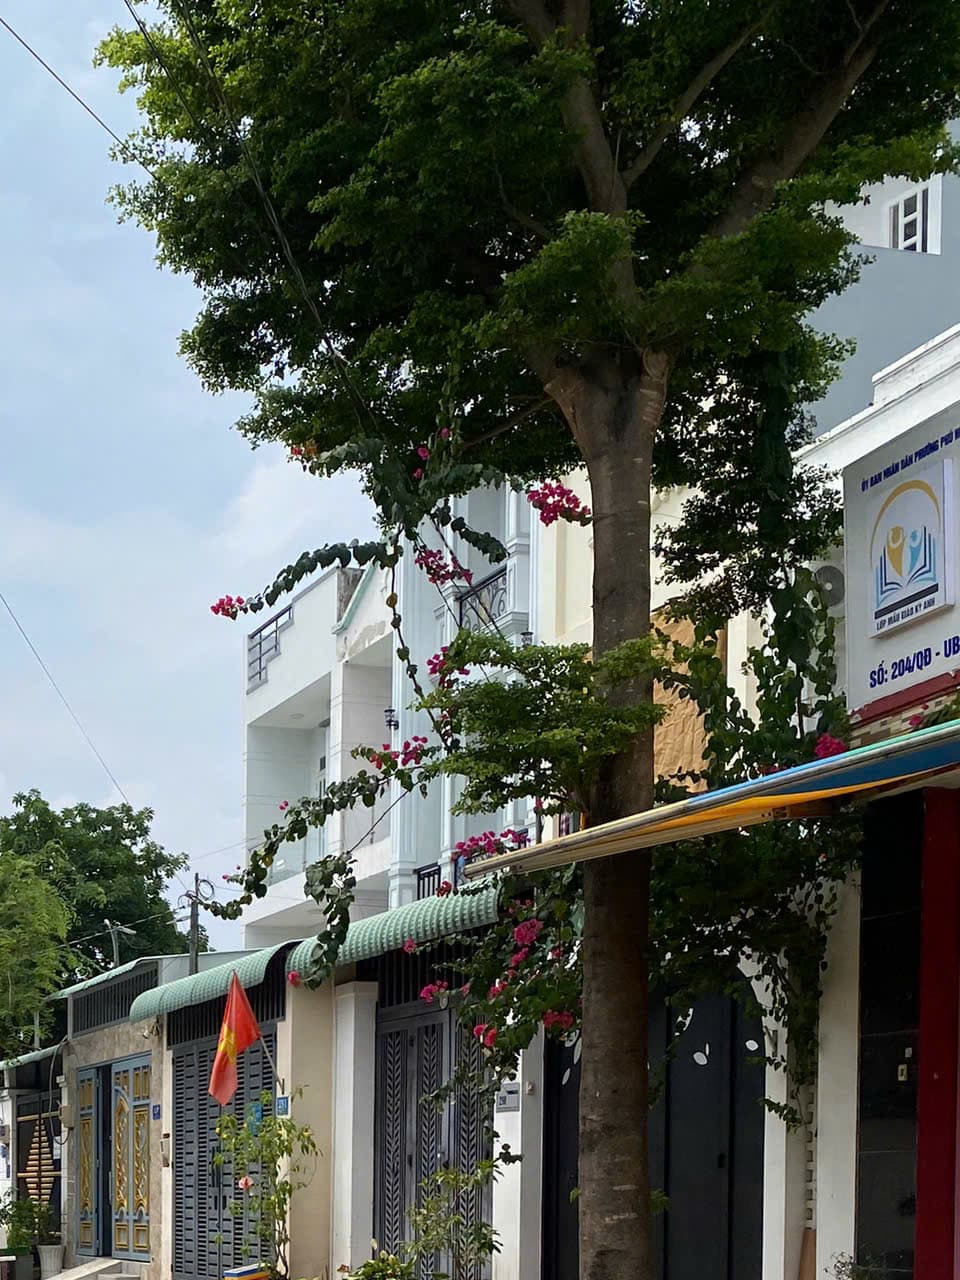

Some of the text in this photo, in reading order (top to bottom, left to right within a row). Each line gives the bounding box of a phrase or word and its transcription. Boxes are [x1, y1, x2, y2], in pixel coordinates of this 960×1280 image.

[870, 472, 883, 488] BAN
[869, 660, 888, 689] SỐ:
[891, 647, 932, 680] 204/QĐ
